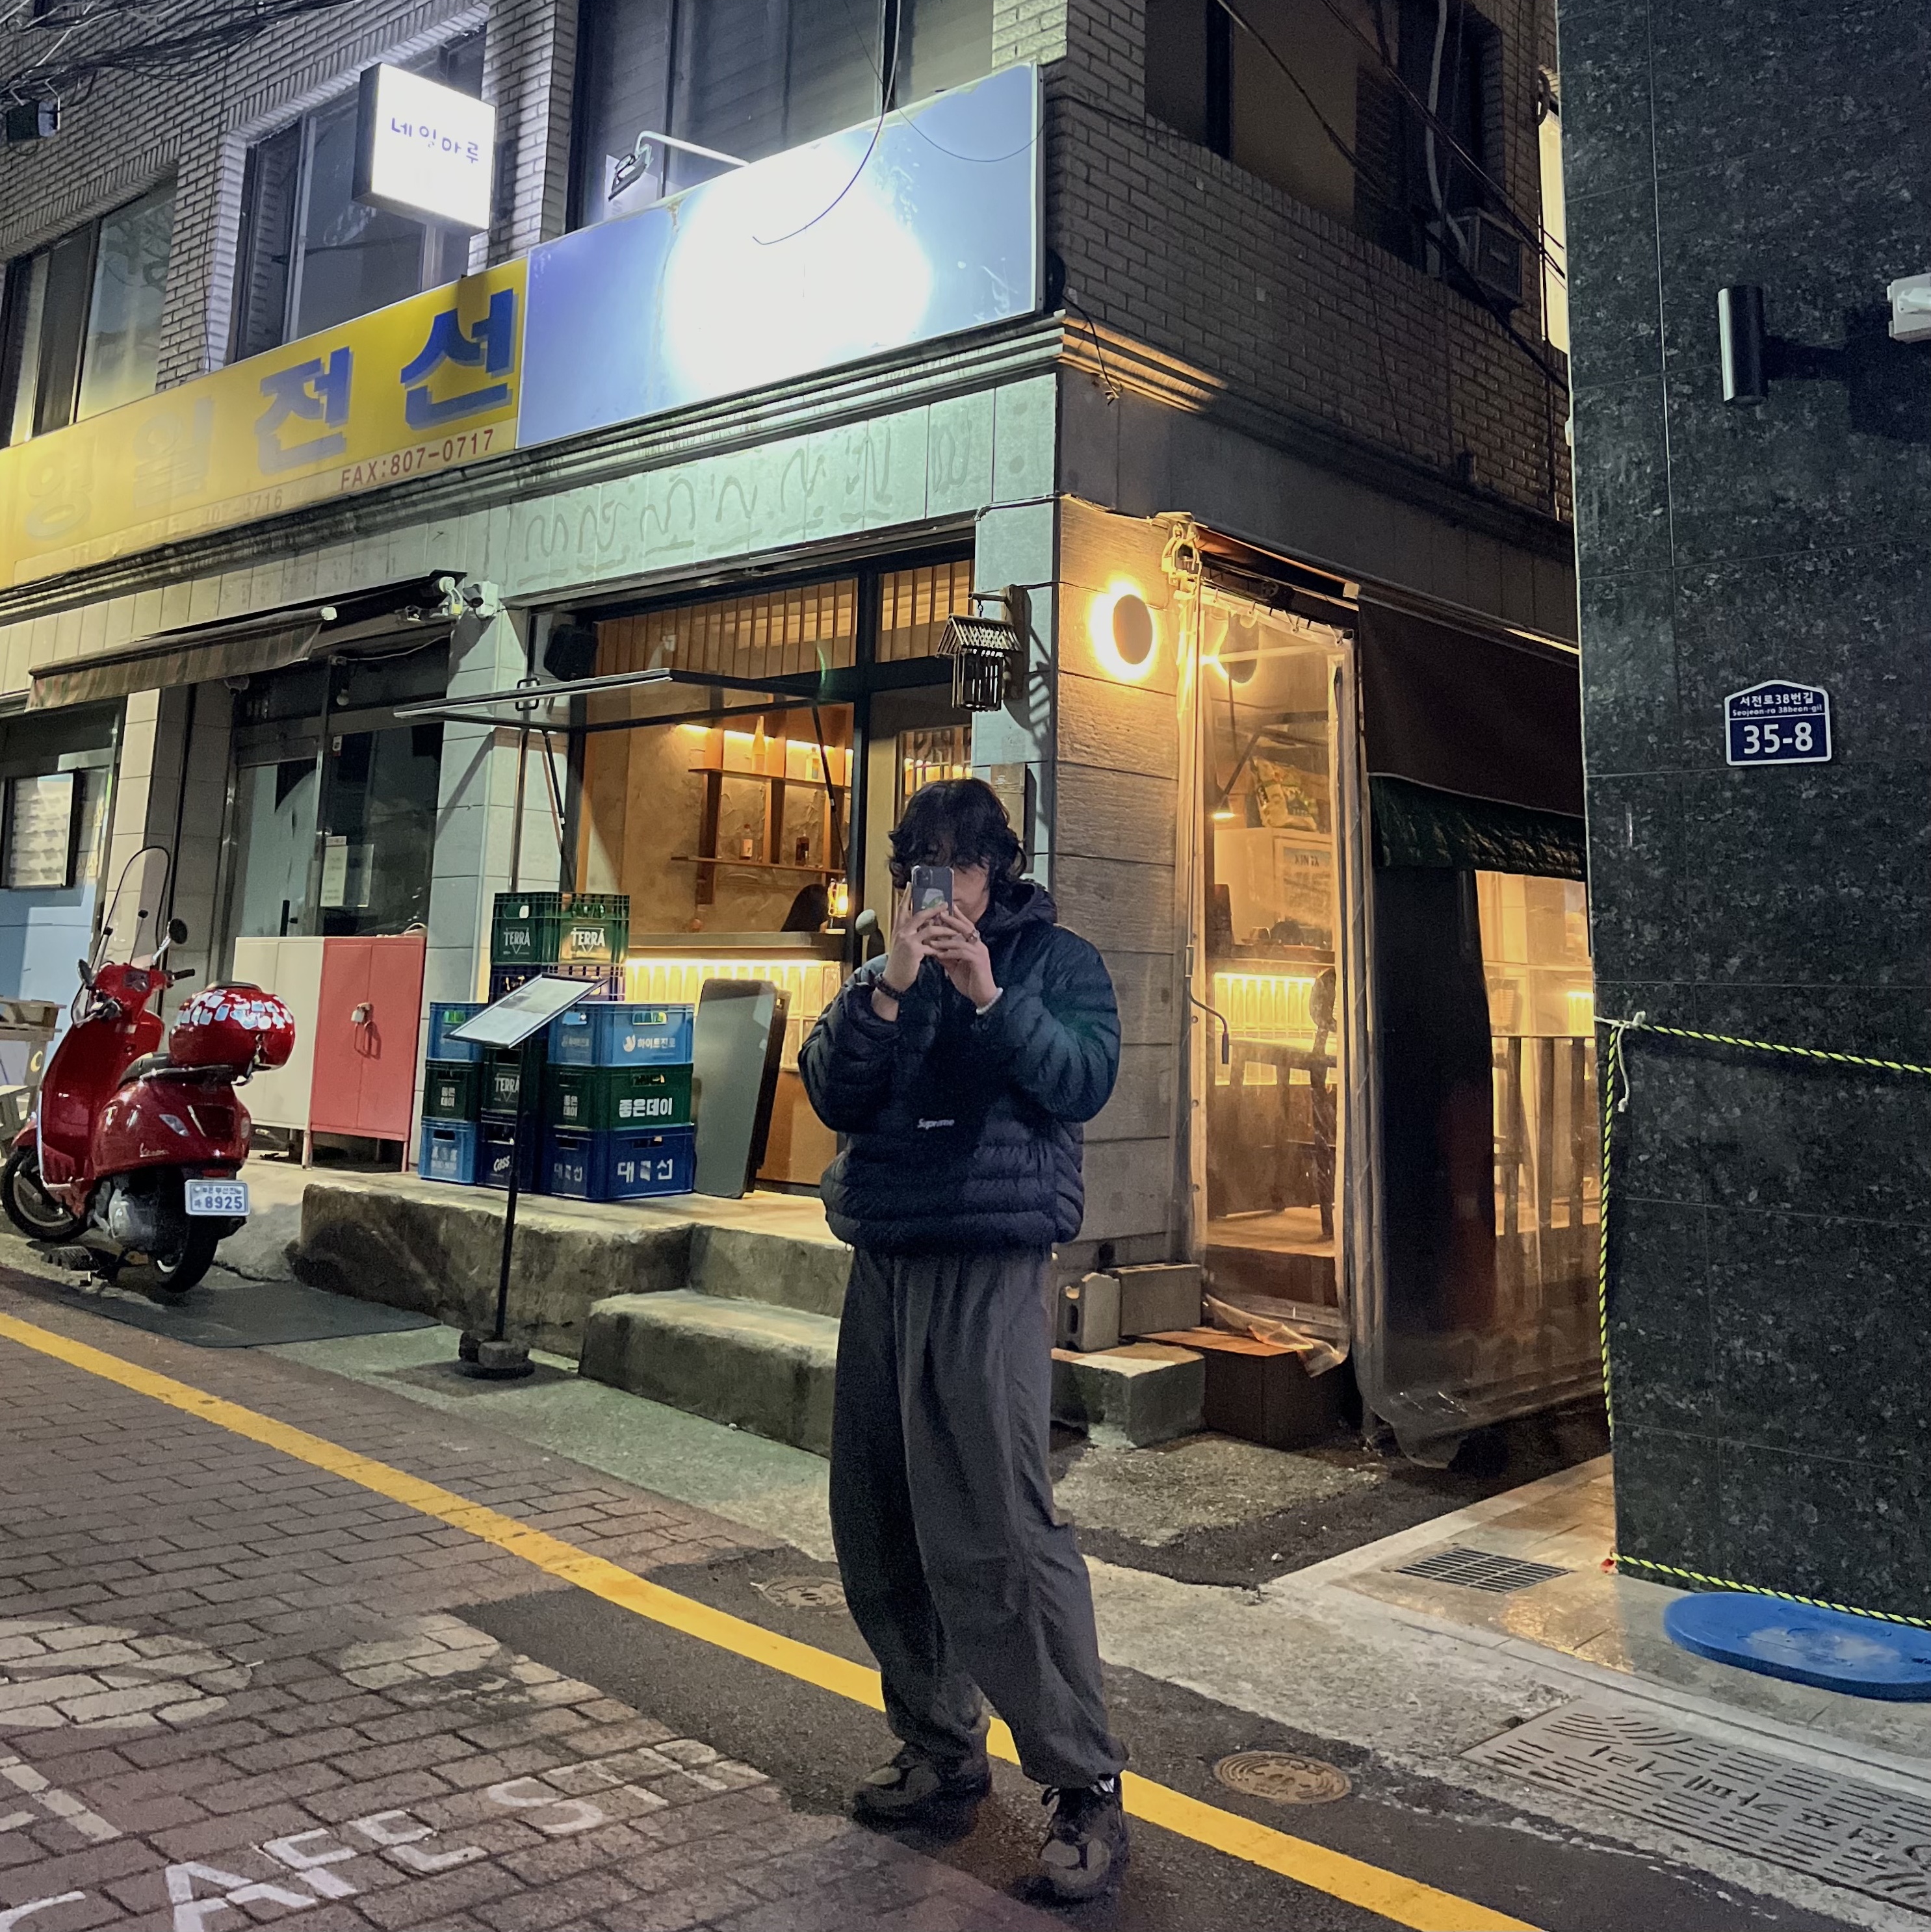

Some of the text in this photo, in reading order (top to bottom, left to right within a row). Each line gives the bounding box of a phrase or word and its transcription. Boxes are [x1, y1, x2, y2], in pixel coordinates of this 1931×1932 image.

[391, 118, 478, 163] 네일마루
[341, 429, 493, 491] FAX:807-0717
[1740, 692, 1813, 707] 서전로38번길
[1732, 704, 1822, 717] Seojeon-ro 38beon-gil
[1744, 722, 1813, 754] 35-8
[504, 931, 530, 946] TERRA
[571, 931, 605, 947] TERRA
[495, 1077, 519, 1092] TERRA
[619, 1098, 673, 1118] 좋은데이
[205, 1196, 242, 1209] 8925
